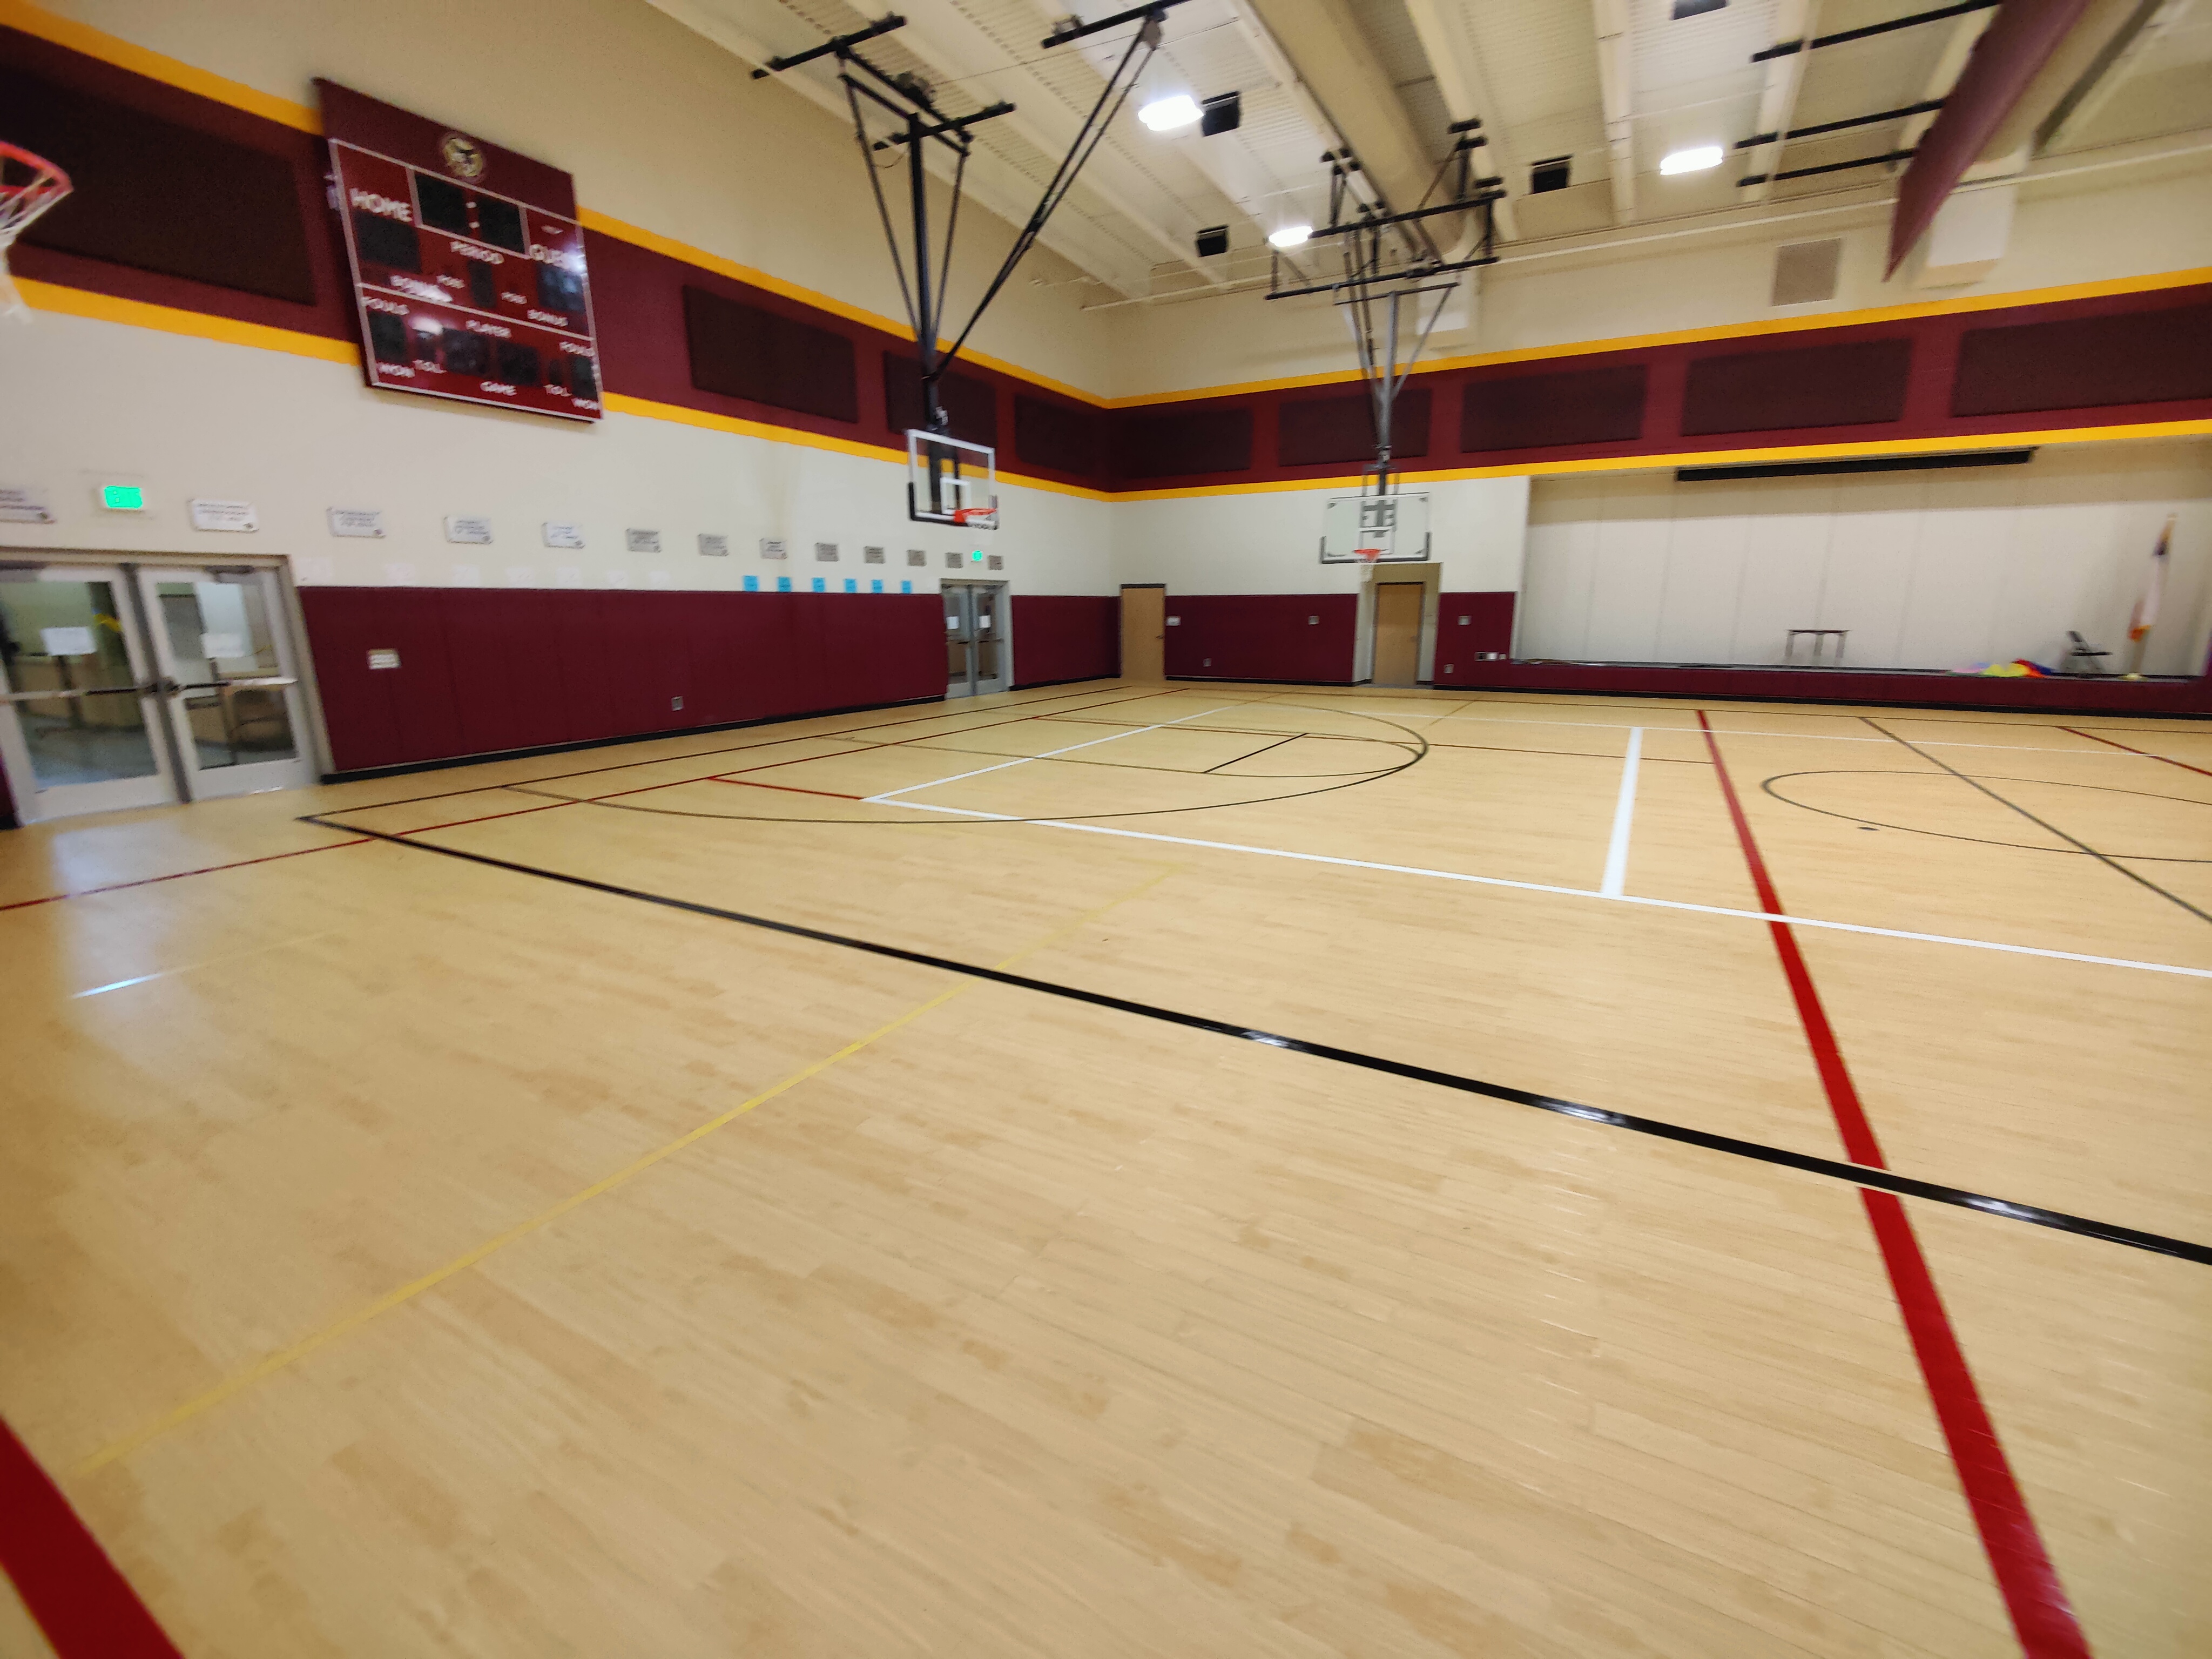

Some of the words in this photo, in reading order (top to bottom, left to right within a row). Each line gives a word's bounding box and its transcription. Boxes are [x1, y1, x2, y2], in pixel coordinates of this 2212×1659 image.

[349, 188, 413, 222] HOME
[450, 241, 505, 265] PERIOD
[529, 244, 589, 273] GUE
[360, 296, 410, 315] FOULS
[466, 320, 512, 339] PLAYER
[480, 381, 517, 396] GAME
